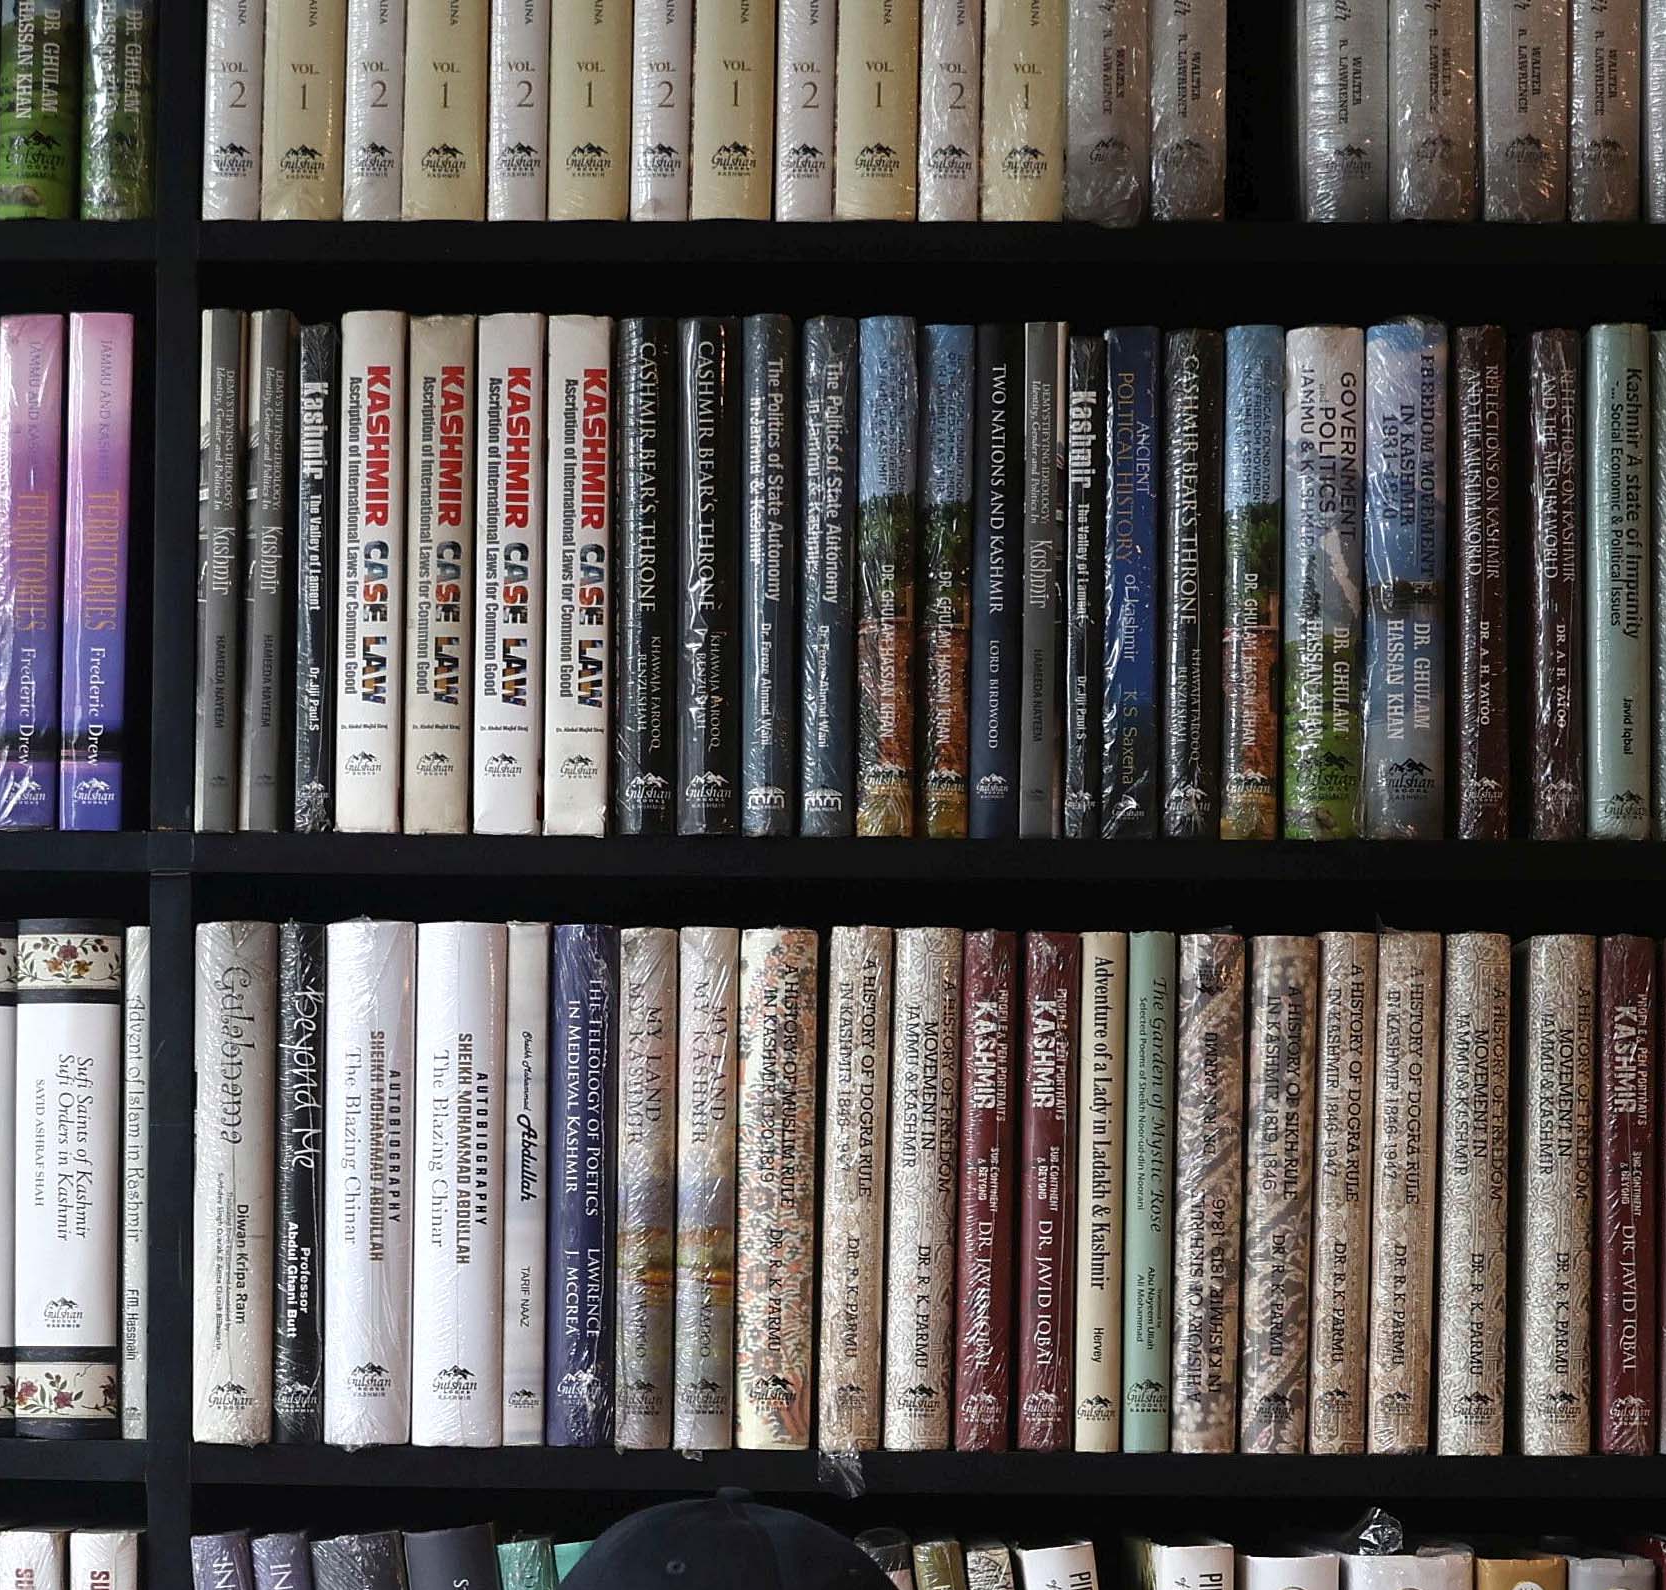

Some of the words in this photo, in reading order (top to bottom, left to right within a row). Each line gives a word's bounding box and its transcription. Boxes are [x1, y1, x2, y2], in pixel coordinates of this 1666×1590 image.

[221, 62, 248, 73] VOL.
[291, 64, 320, 74] VOL.
[229, 81, 247, 108] 2
[300, 83, 307, 110] 1
[280, 159, 324, 173] Gulshan
[639, 342, 656, 440] CASHMIR
[990, 364, 1005, 405] TWO
[563, 379, 578, 444] Ascription
[564, 447, 578, 459] of
[581, 367, 606, 529] KASHMIR
[990, 409, 1006, 487] NATIONS
[561, 462, 577, 546] International
[990, 490, 1005, 531] AND
[561, 549, 576, 580] Laws
[579, 543, 605, 626] CASE
[639, 519, 655, 611] THRONE
[989, 535, 1005, 614] KASHMIR
[561, 583, 576, 601] for
[560, 605, 575, 661] Common
[989, 640, 999, 673] LORD
[87, 647, 106, 716] Frederic
[559, 664, 574, 697] Good
[578, 639, 603, 708] LAW
[988, 678, 999, 748] BIRDWOOD
[87, 724, 104, 766] Drew
[1092, 957, 1114, 1038] Adventure
[75, 1057, 94, 1090] Sufi
[432, 1050, 449, 1088] The
[457, 1033, 473, 1085] SHEIKH
[1092, 1063, 1106, 1073] a
[1093, 1042, 1112, 1059] of
[76, 1094, 93, 1144] Saints
[1089, 1076, 1112, 1114] Lady
[428, 1098, 449, 1171] Blazing
[457, 1090, 472, 1186] MOHAMMAD
[476, 1073, 488, 1225] AUTOBIOGRAPHY
[1092, 1118, 1110, 1134] in
[74, 1148, 93, 1167] of
[1092, 1137, 1111, 1198] Ladakh
[74, 1171, 93, 1239] Kashmir
[430, 1179, 448, 1248] Chinar
[456, 1189, 471, 1264] ABDULLAH
[1092, 1205, 1109, 1217] &
[1090, 1222, 1108, 1290] Kashmir
[1091, 1327, 1105, 1362] Hervey
